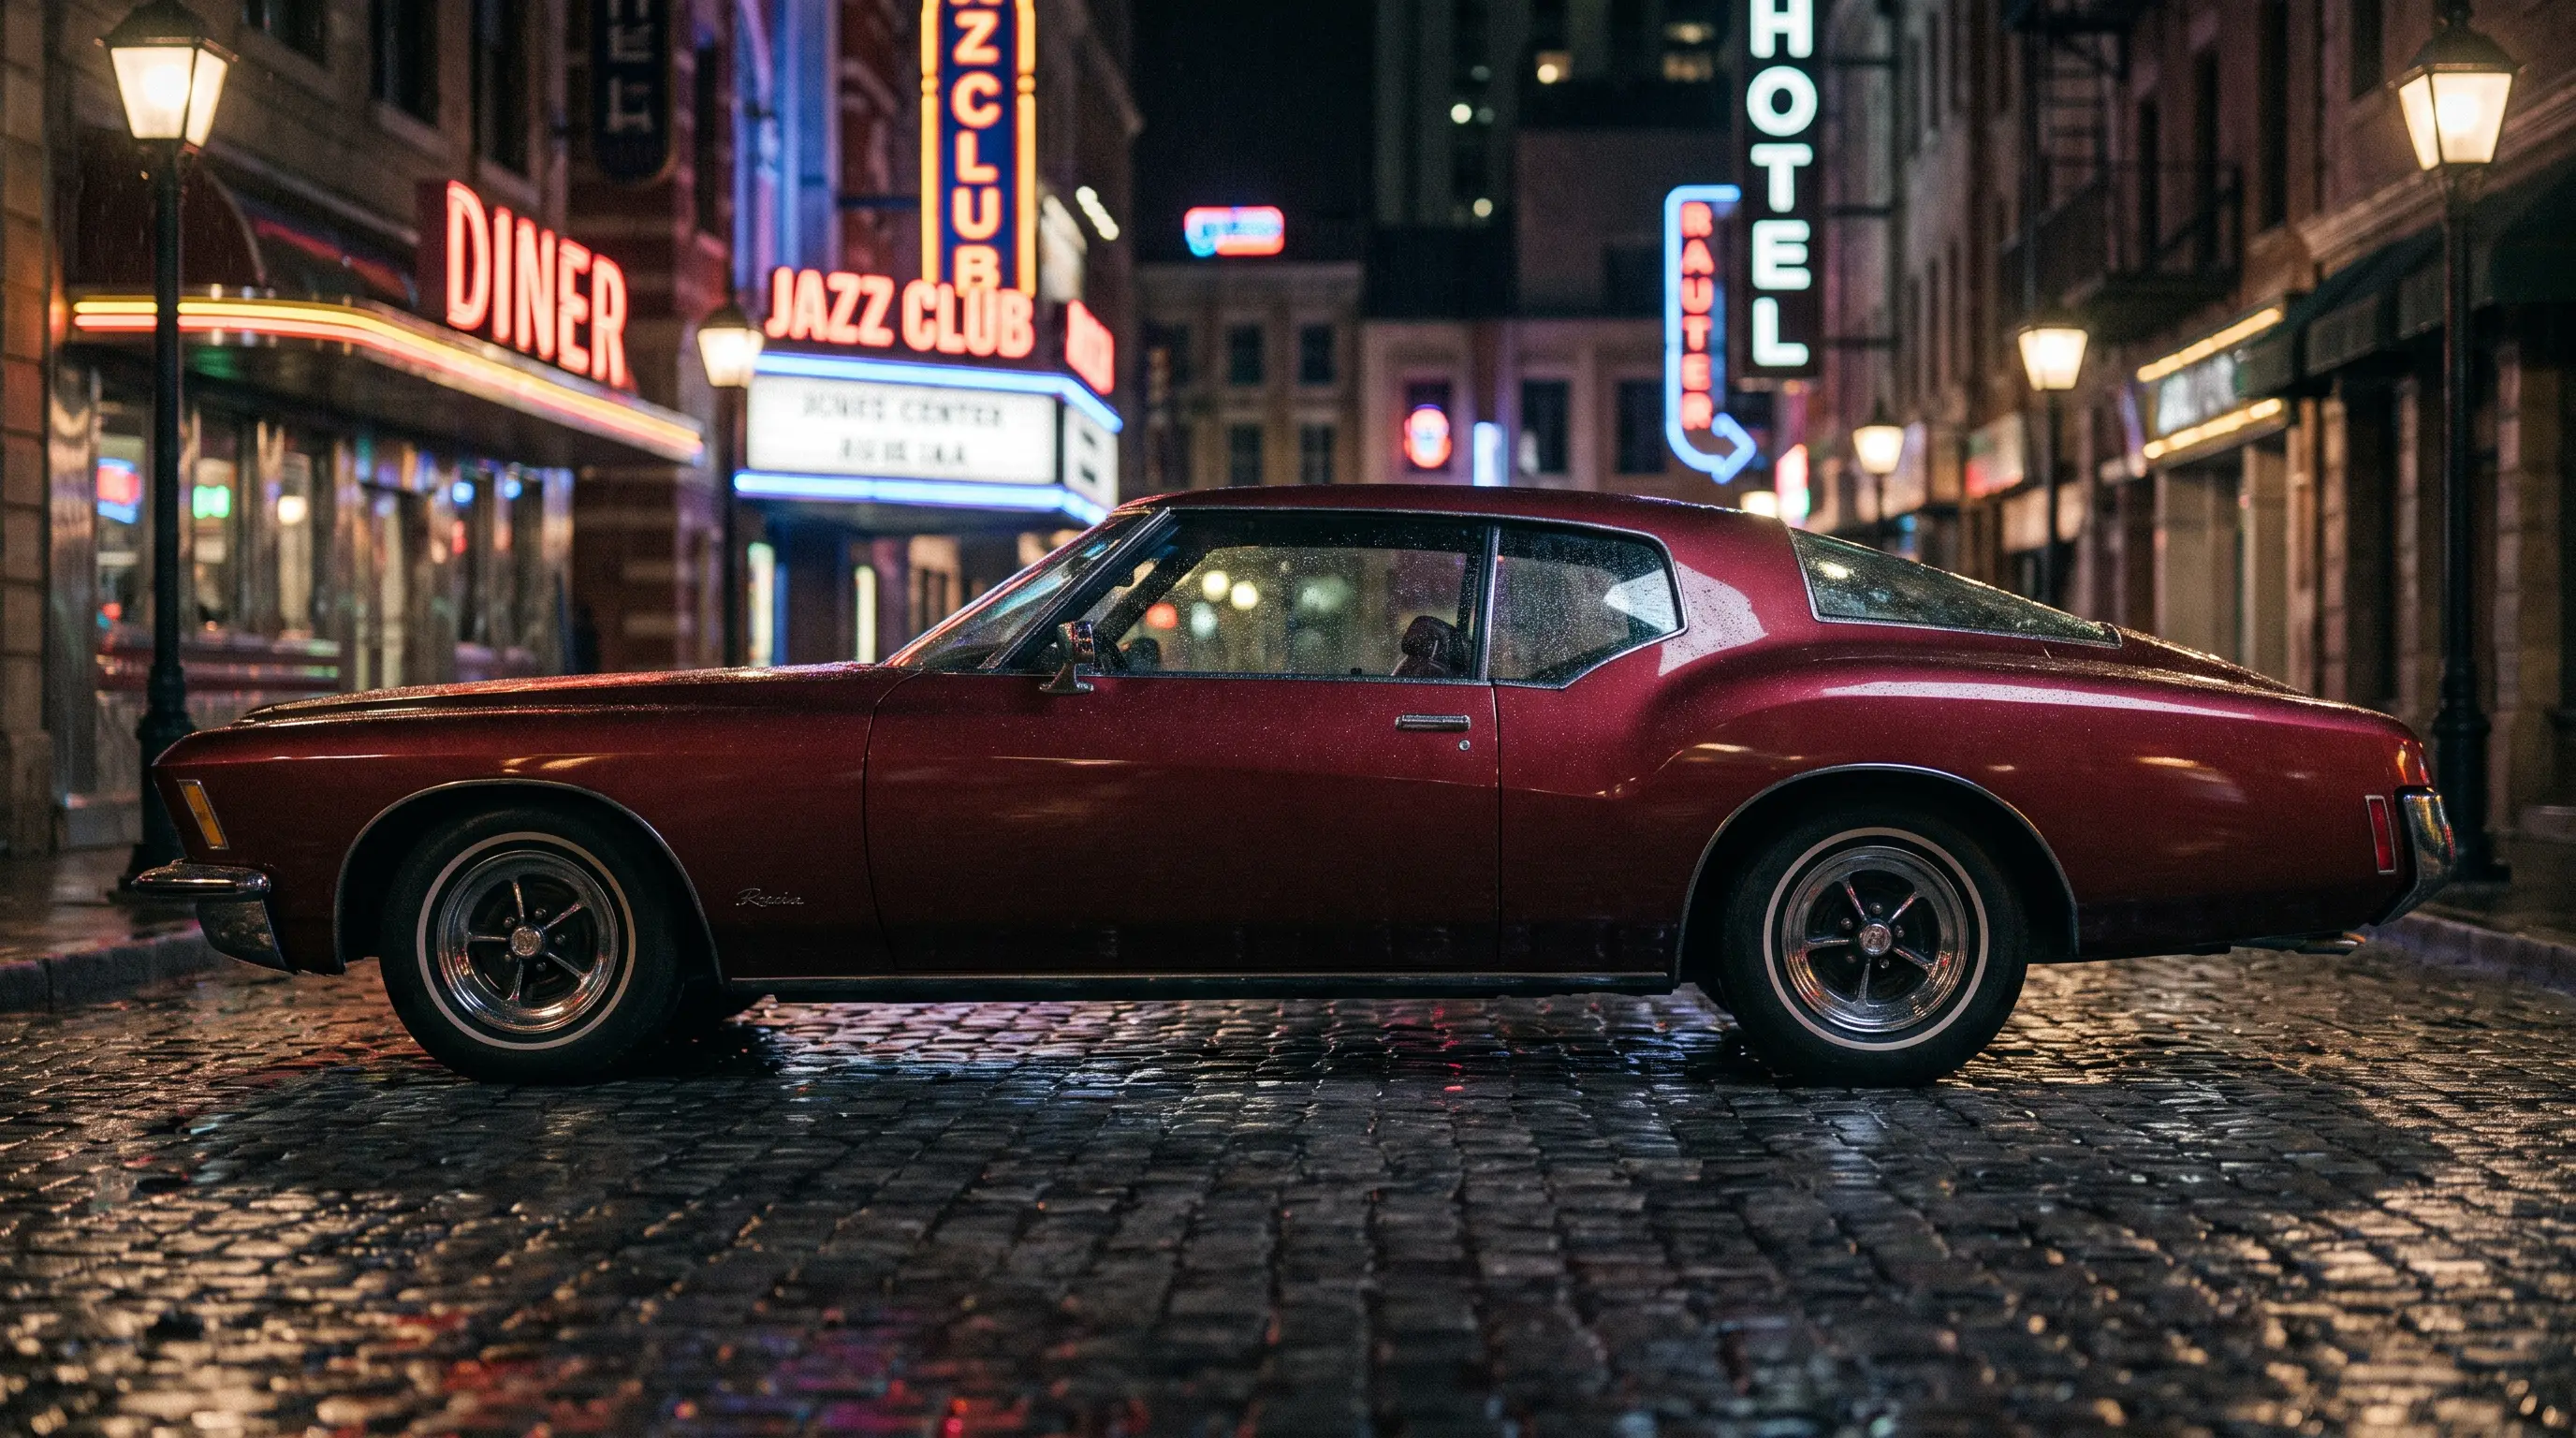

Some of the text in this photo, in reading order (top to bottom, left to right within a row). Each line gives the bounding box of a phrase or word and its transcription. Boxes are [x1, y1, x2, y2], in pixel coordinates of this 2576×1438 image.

[950, 0, 1004, 298] ZCLUB
[1747, 0, 1819, 367] HOTEL
[446, 179, 628, 389] DINER
[765, 266, 895, 347] JAZZ
[901, 278, 1035, 359] CLUB
